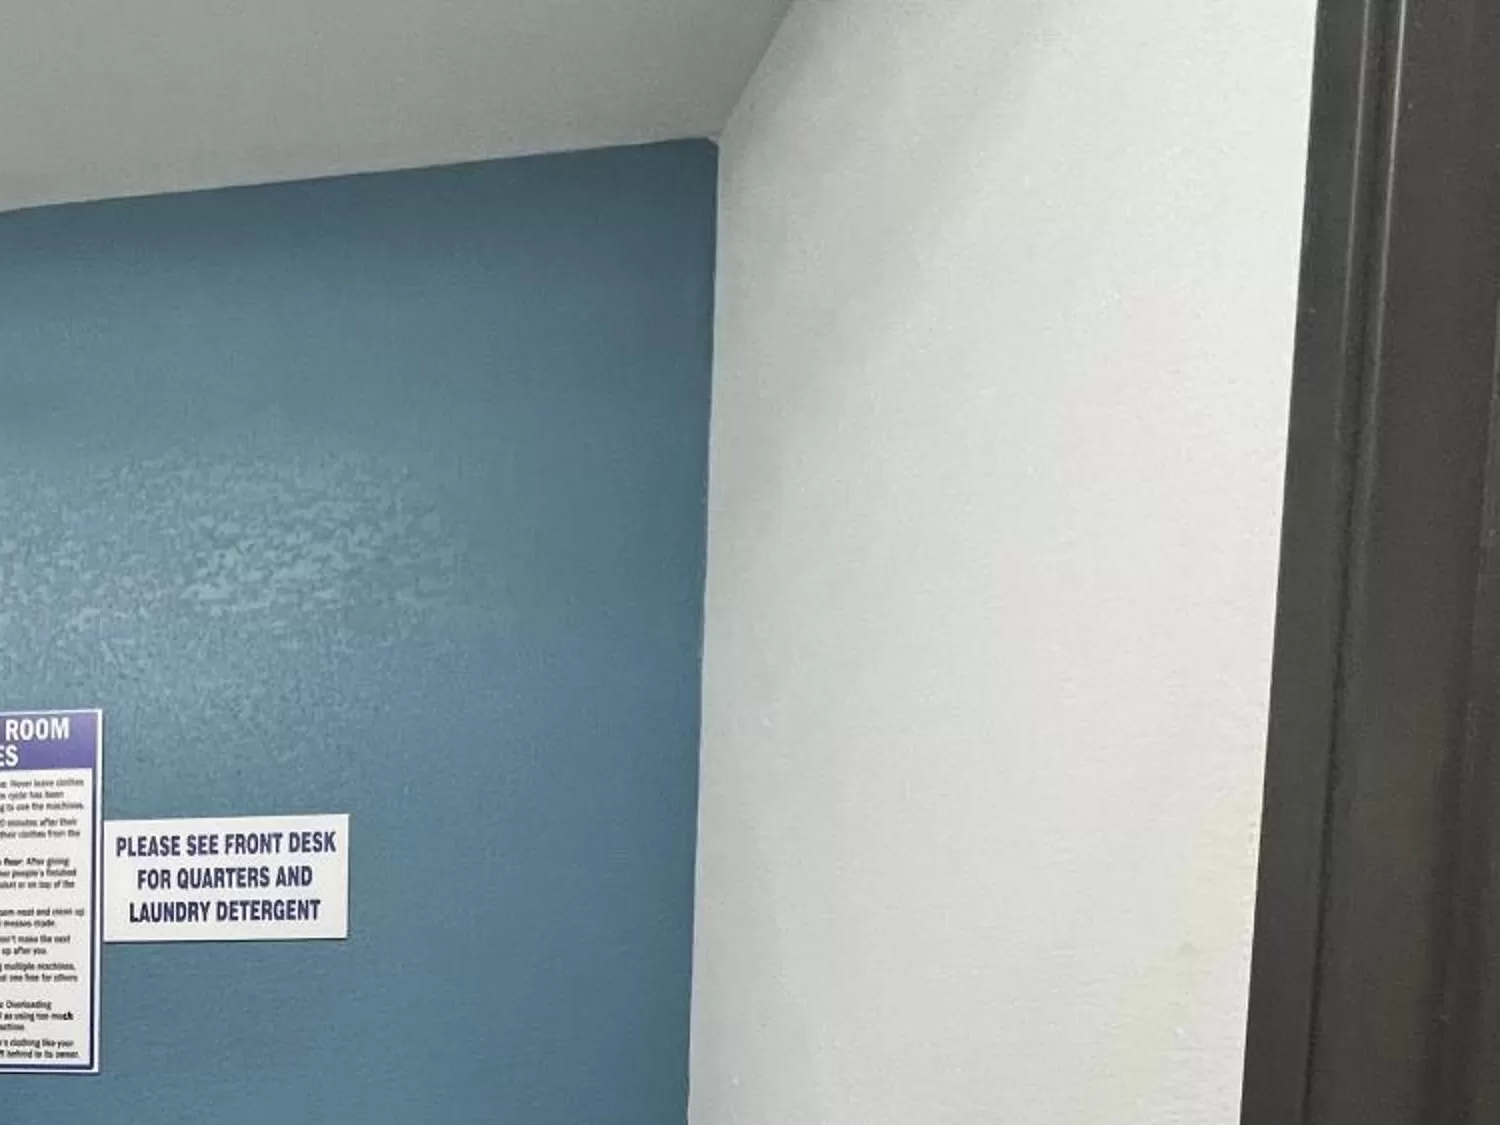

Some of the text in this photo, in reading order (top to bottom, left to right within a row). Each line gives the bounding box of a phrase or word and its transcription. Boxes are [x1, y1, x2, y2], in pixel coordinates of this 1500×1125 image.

[5, 717, 71, 741] ROOM
[116, 830, 337, 856] PLEASE SEE FRONT DESK
[137, 865, 313, 890] FOR QUARTERS AND
[129, 899, 321, 923] LAUNDRY DETERGENT
